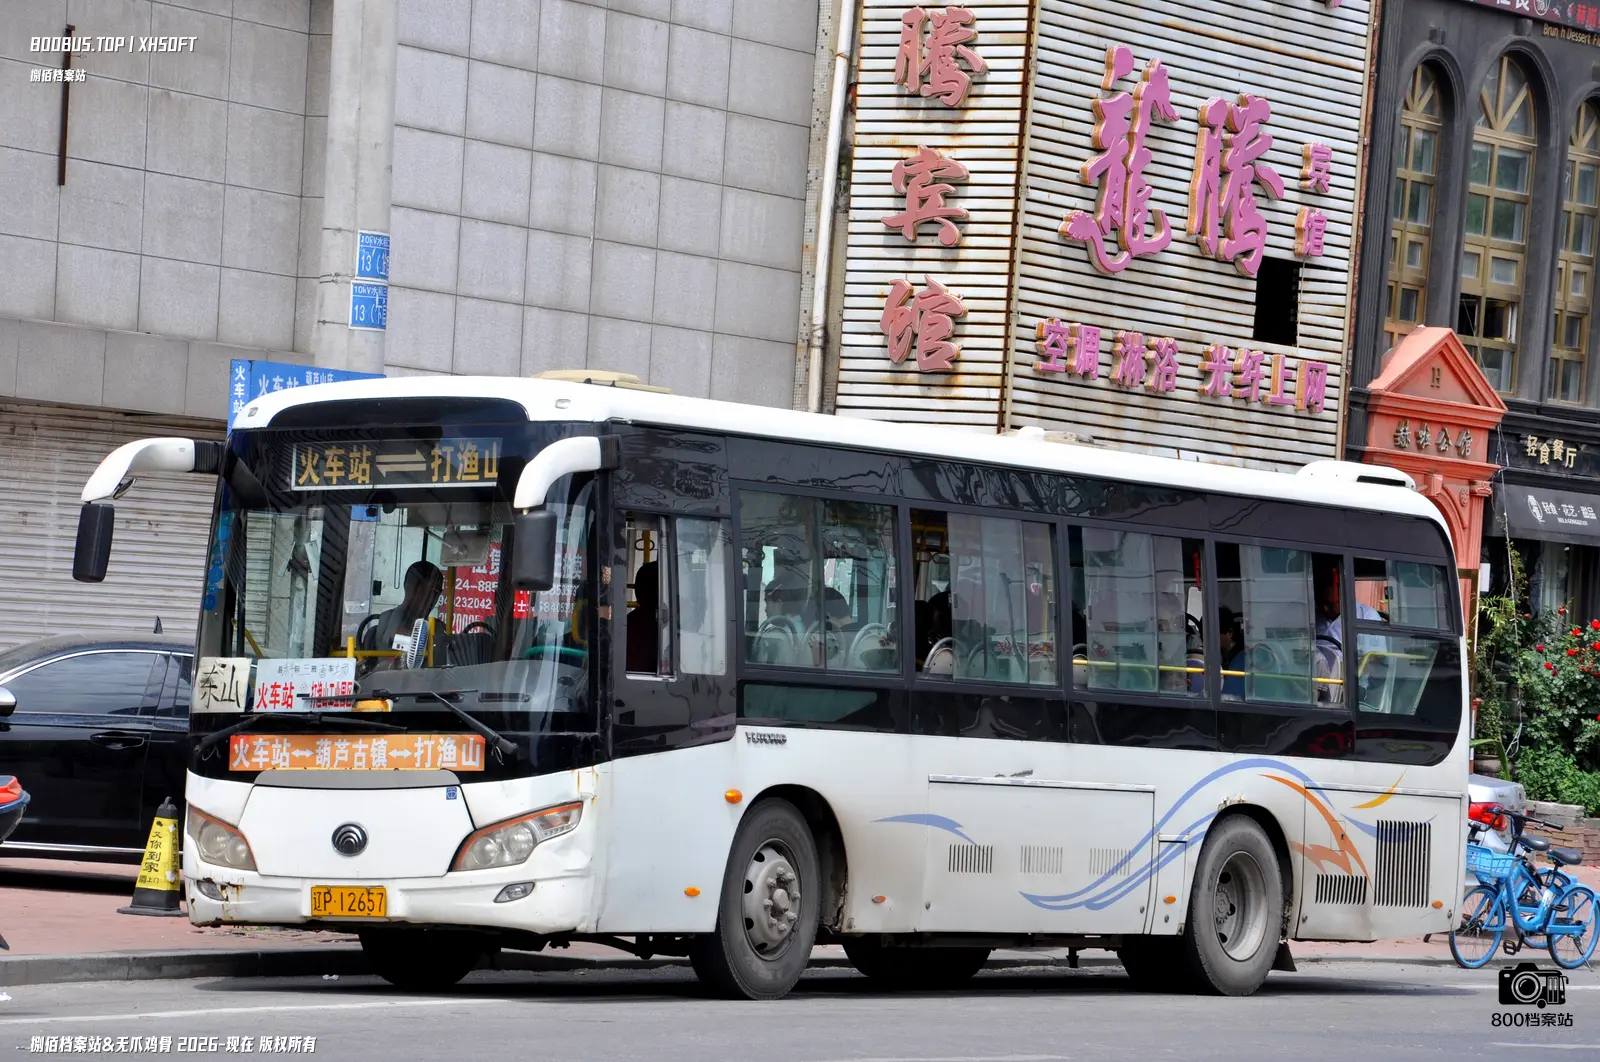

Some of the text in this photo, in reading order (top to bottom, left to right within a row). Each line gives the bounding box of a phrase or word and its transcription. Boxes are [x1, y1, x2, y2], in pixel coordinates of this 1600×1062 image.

[1032, 317, 1328, 414] 空调 淋浴 光纤上网
[233, 365, 246, 414] 火车站
[298, 440, 499, 485] 火车站 打渔山
[1525, 435, 1578, 469] 轻食餐厅
[256, 681, 295, 710] 火车站
[232, 736, 481, 769] 火车站 葫芦古镇 打渔山
[313, 891, 385, 913] 辽P·12657
